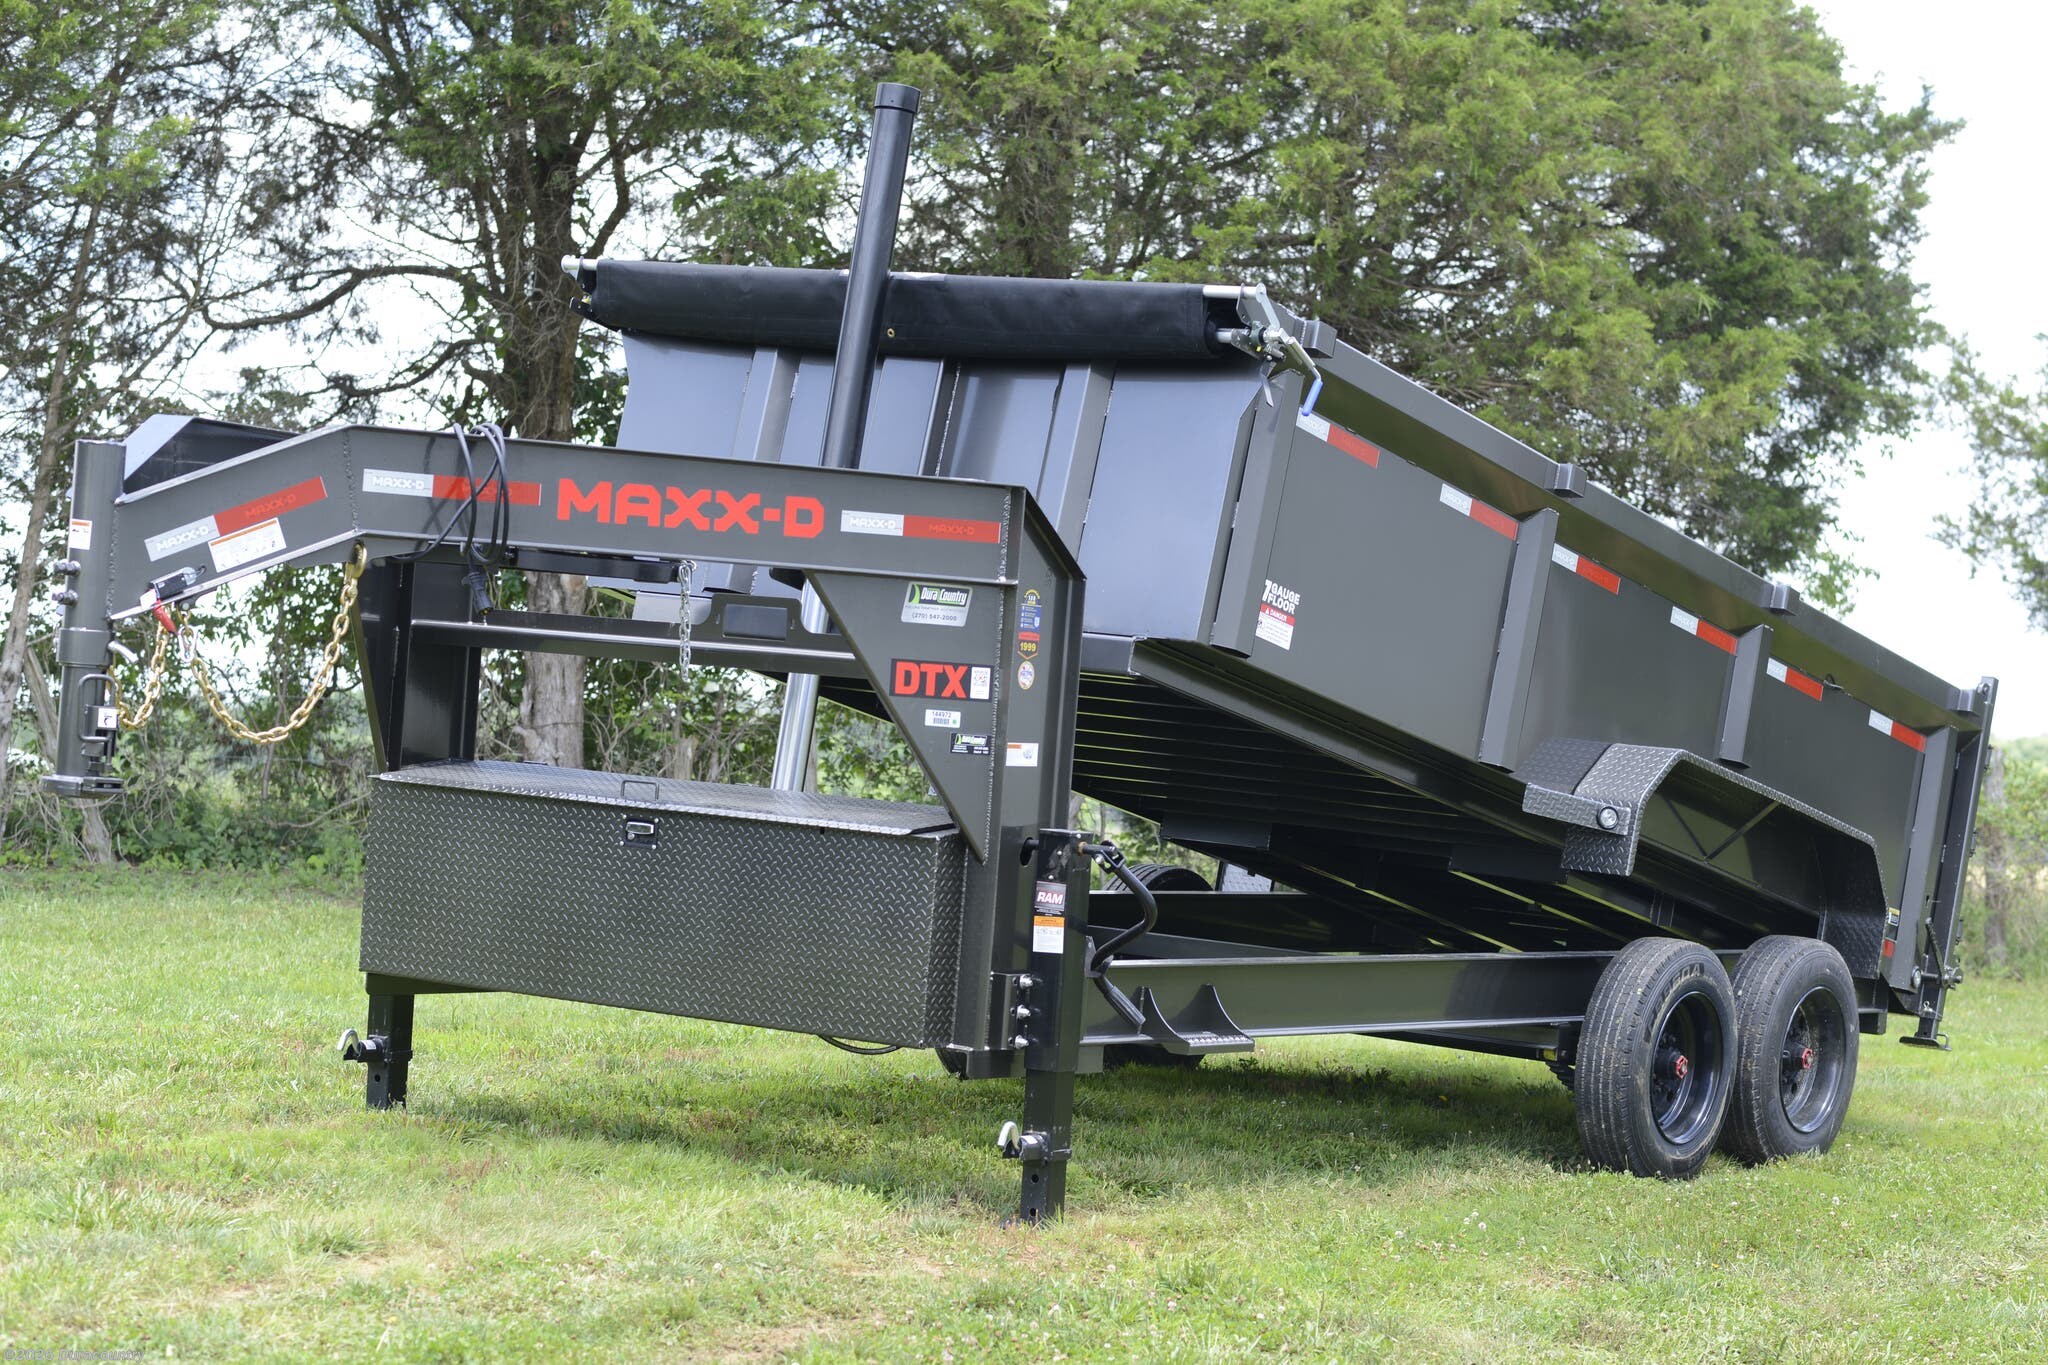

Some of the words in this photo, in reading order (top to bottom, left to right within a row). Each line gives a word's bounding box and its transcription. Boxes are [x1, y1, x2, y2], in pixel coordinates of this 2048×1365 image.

[371, 475, 425, 491] MAXX-D
[244, 493, 297, 519] MAXX-D
[557, 478, 825, 539] MAXX-D
[848, 516, 897, 530] MAXX-D
[928, 523, 976, 536] MAXX-D
[155, 525, 209, 552] MAXX-D
[920, 586, 938, 601] Dura
[940, 588, 968, 606] Country
[1262, 579, 1273, 602] 7
[1271, 583, 1301, 606] GAUGE
[1267, 593, 1296, 615] FLOOR
[1020, 642, 1037, 652] 1999
[894, 660, 968, 699] DTX
[1036, 891, 1064, 905] RAM
